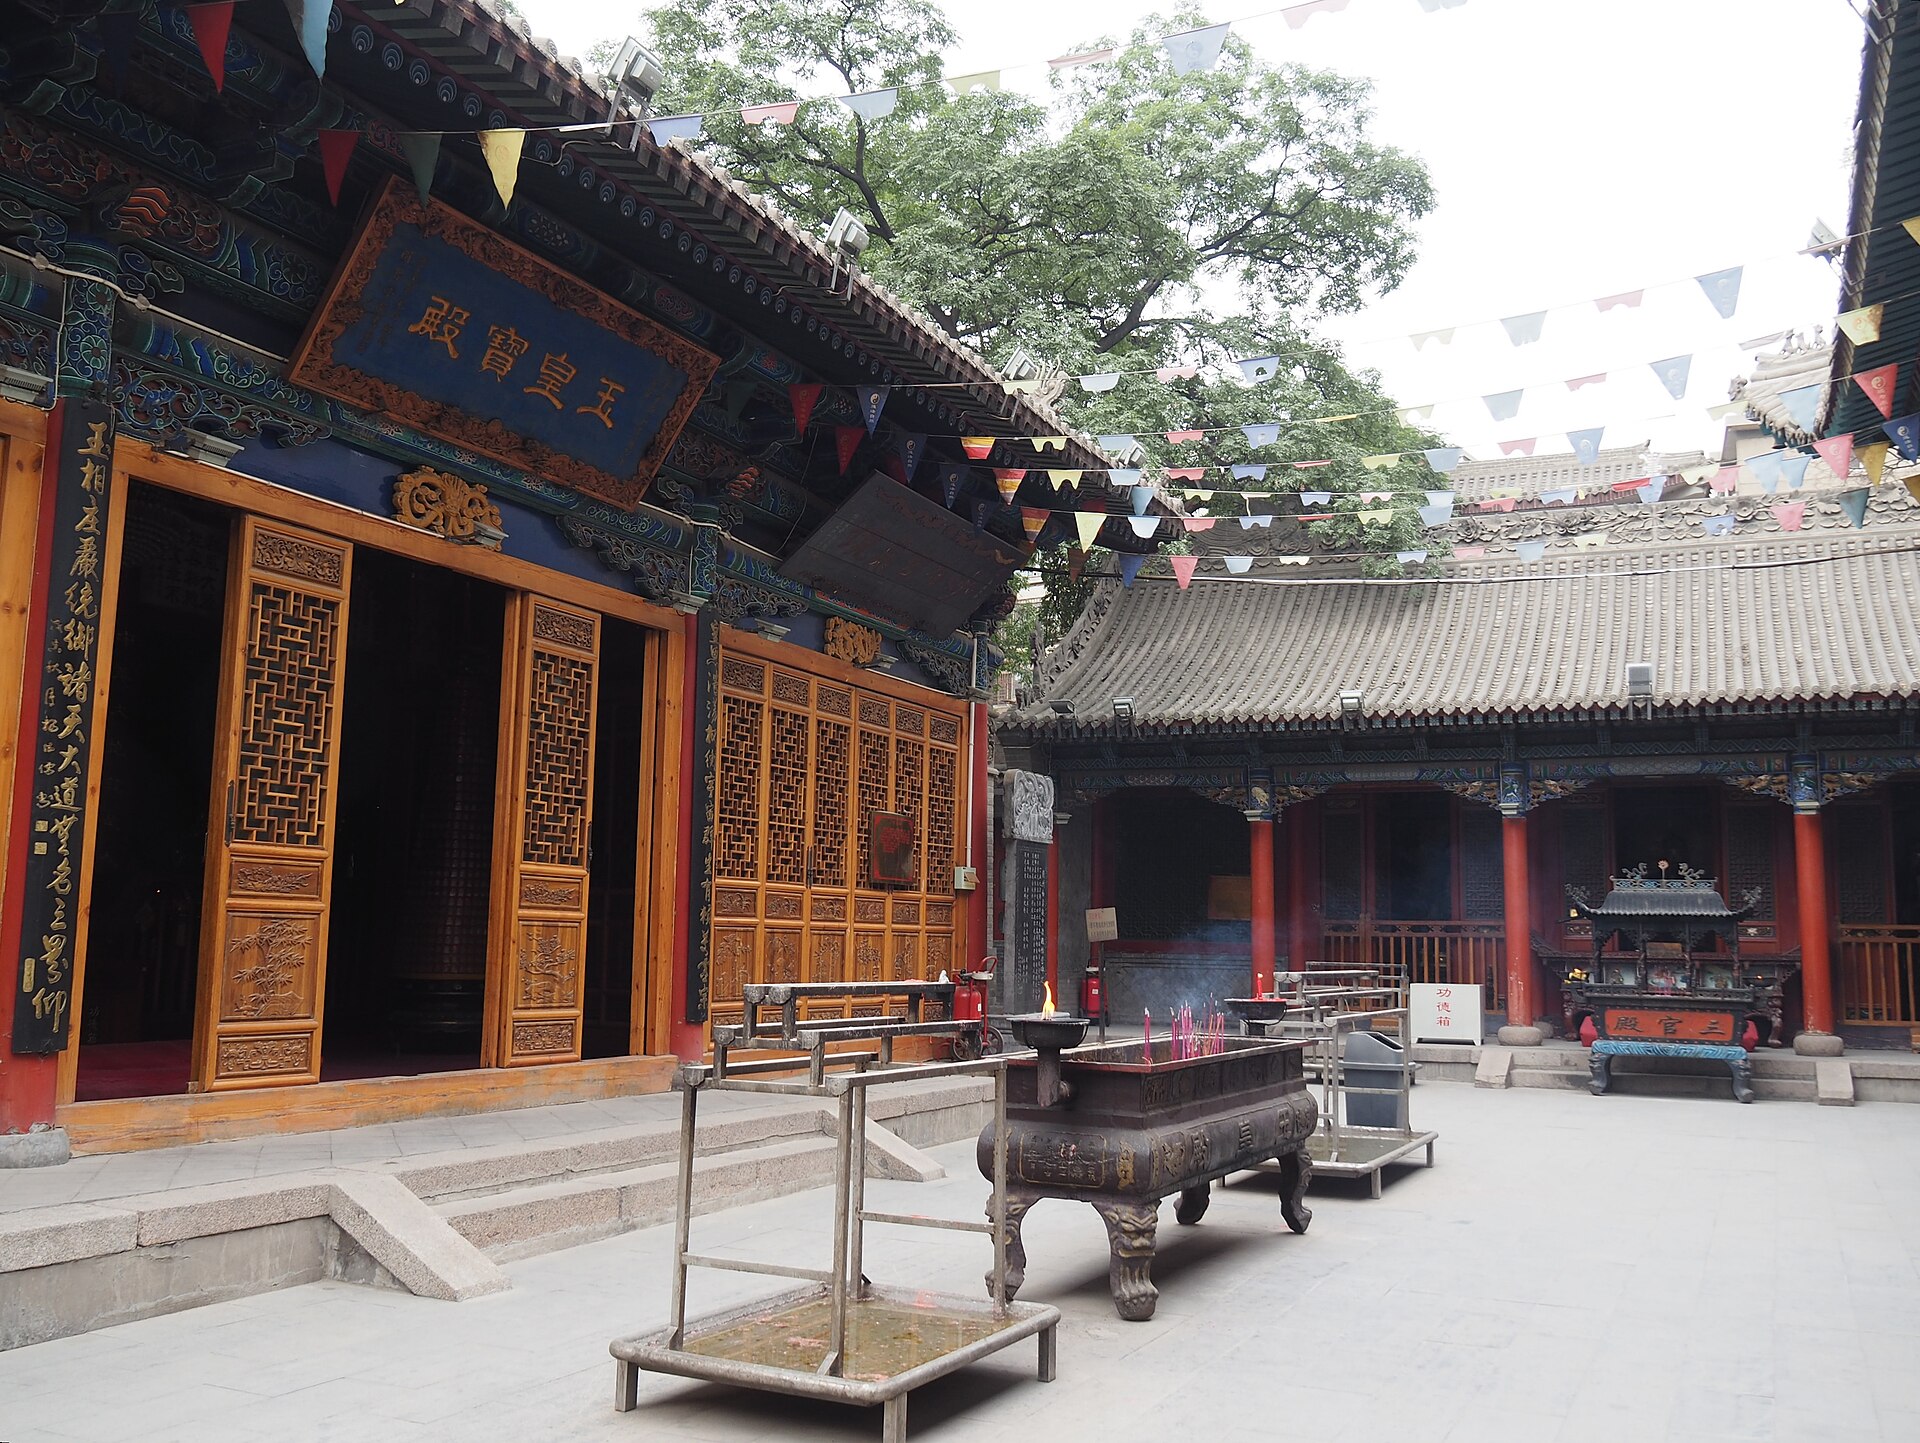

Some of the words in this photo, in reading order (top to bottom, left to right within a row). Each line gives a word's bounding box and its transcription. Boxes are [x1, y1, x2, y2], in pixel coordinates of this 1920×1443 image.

[1436, 987, 1452, 1026] 功德箱
[1614, 1015, 1726, 1035] 三官殿
